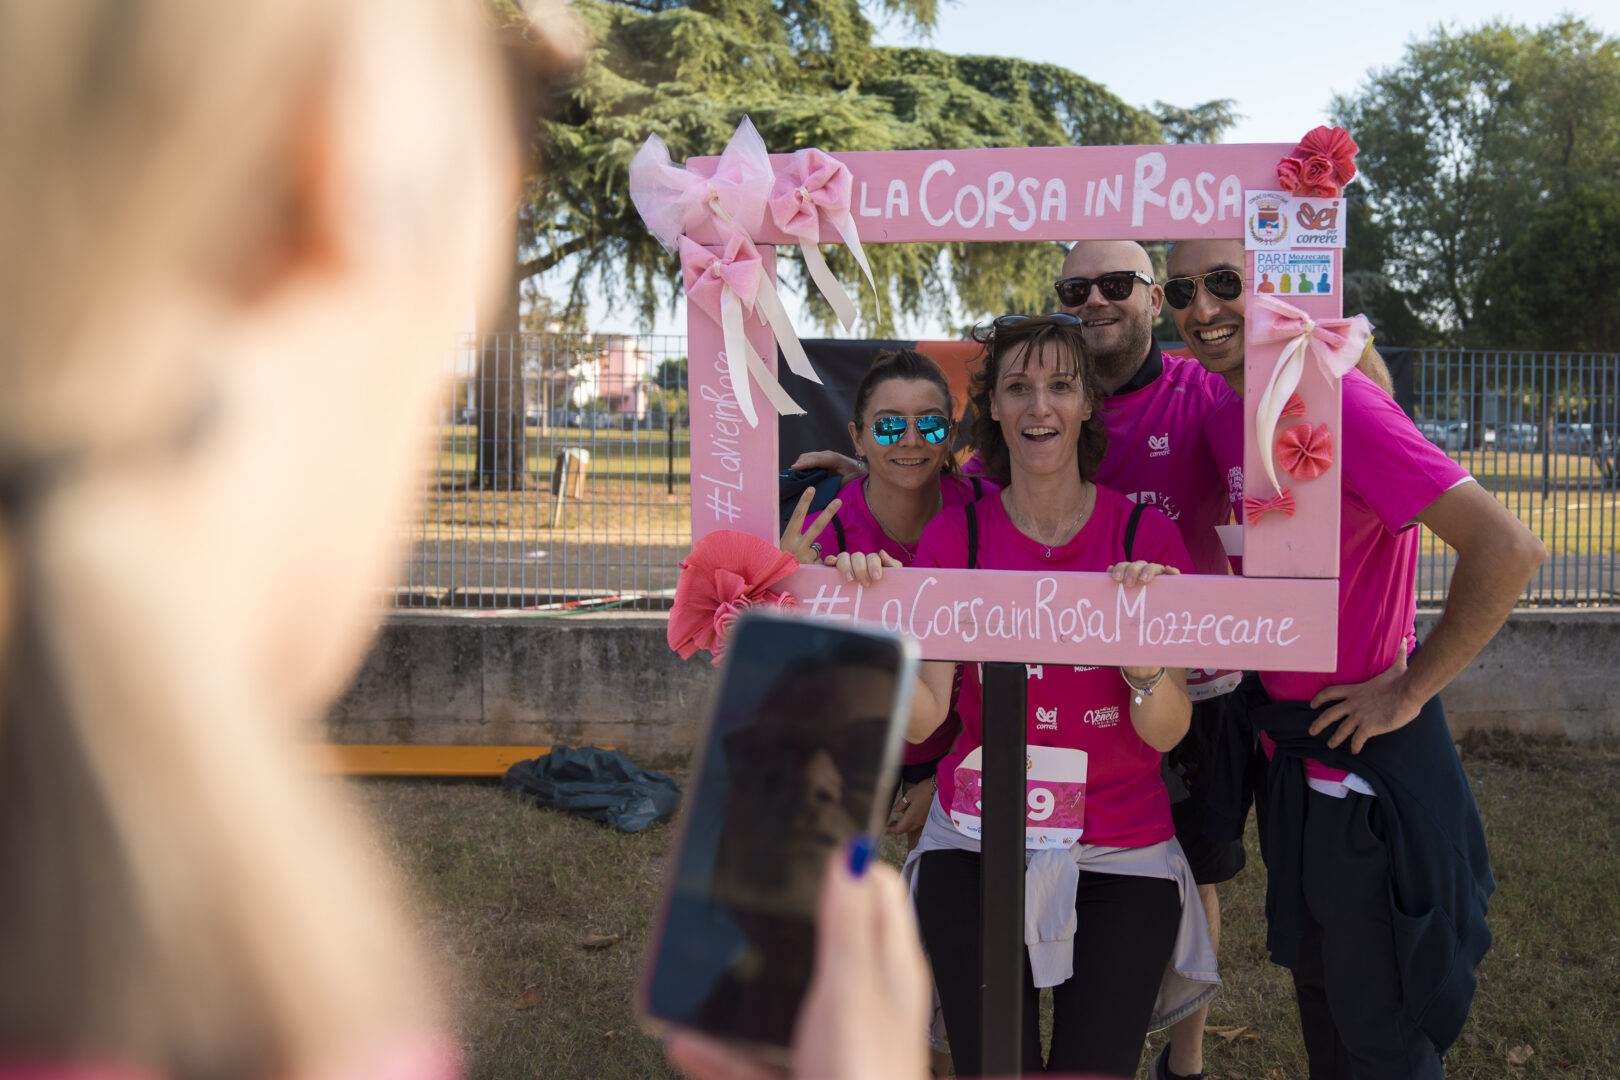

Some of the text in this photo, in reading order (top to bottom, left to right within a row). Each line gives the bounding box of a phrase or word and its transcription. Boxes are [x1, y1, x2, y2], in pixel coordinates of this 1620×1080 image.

[860, 178, 909, 219] LA
[1084, 174, 1123, 216] IN
[1296, 233, 1338, 244] correre
[1257, 253, 1286, 264] PARI
